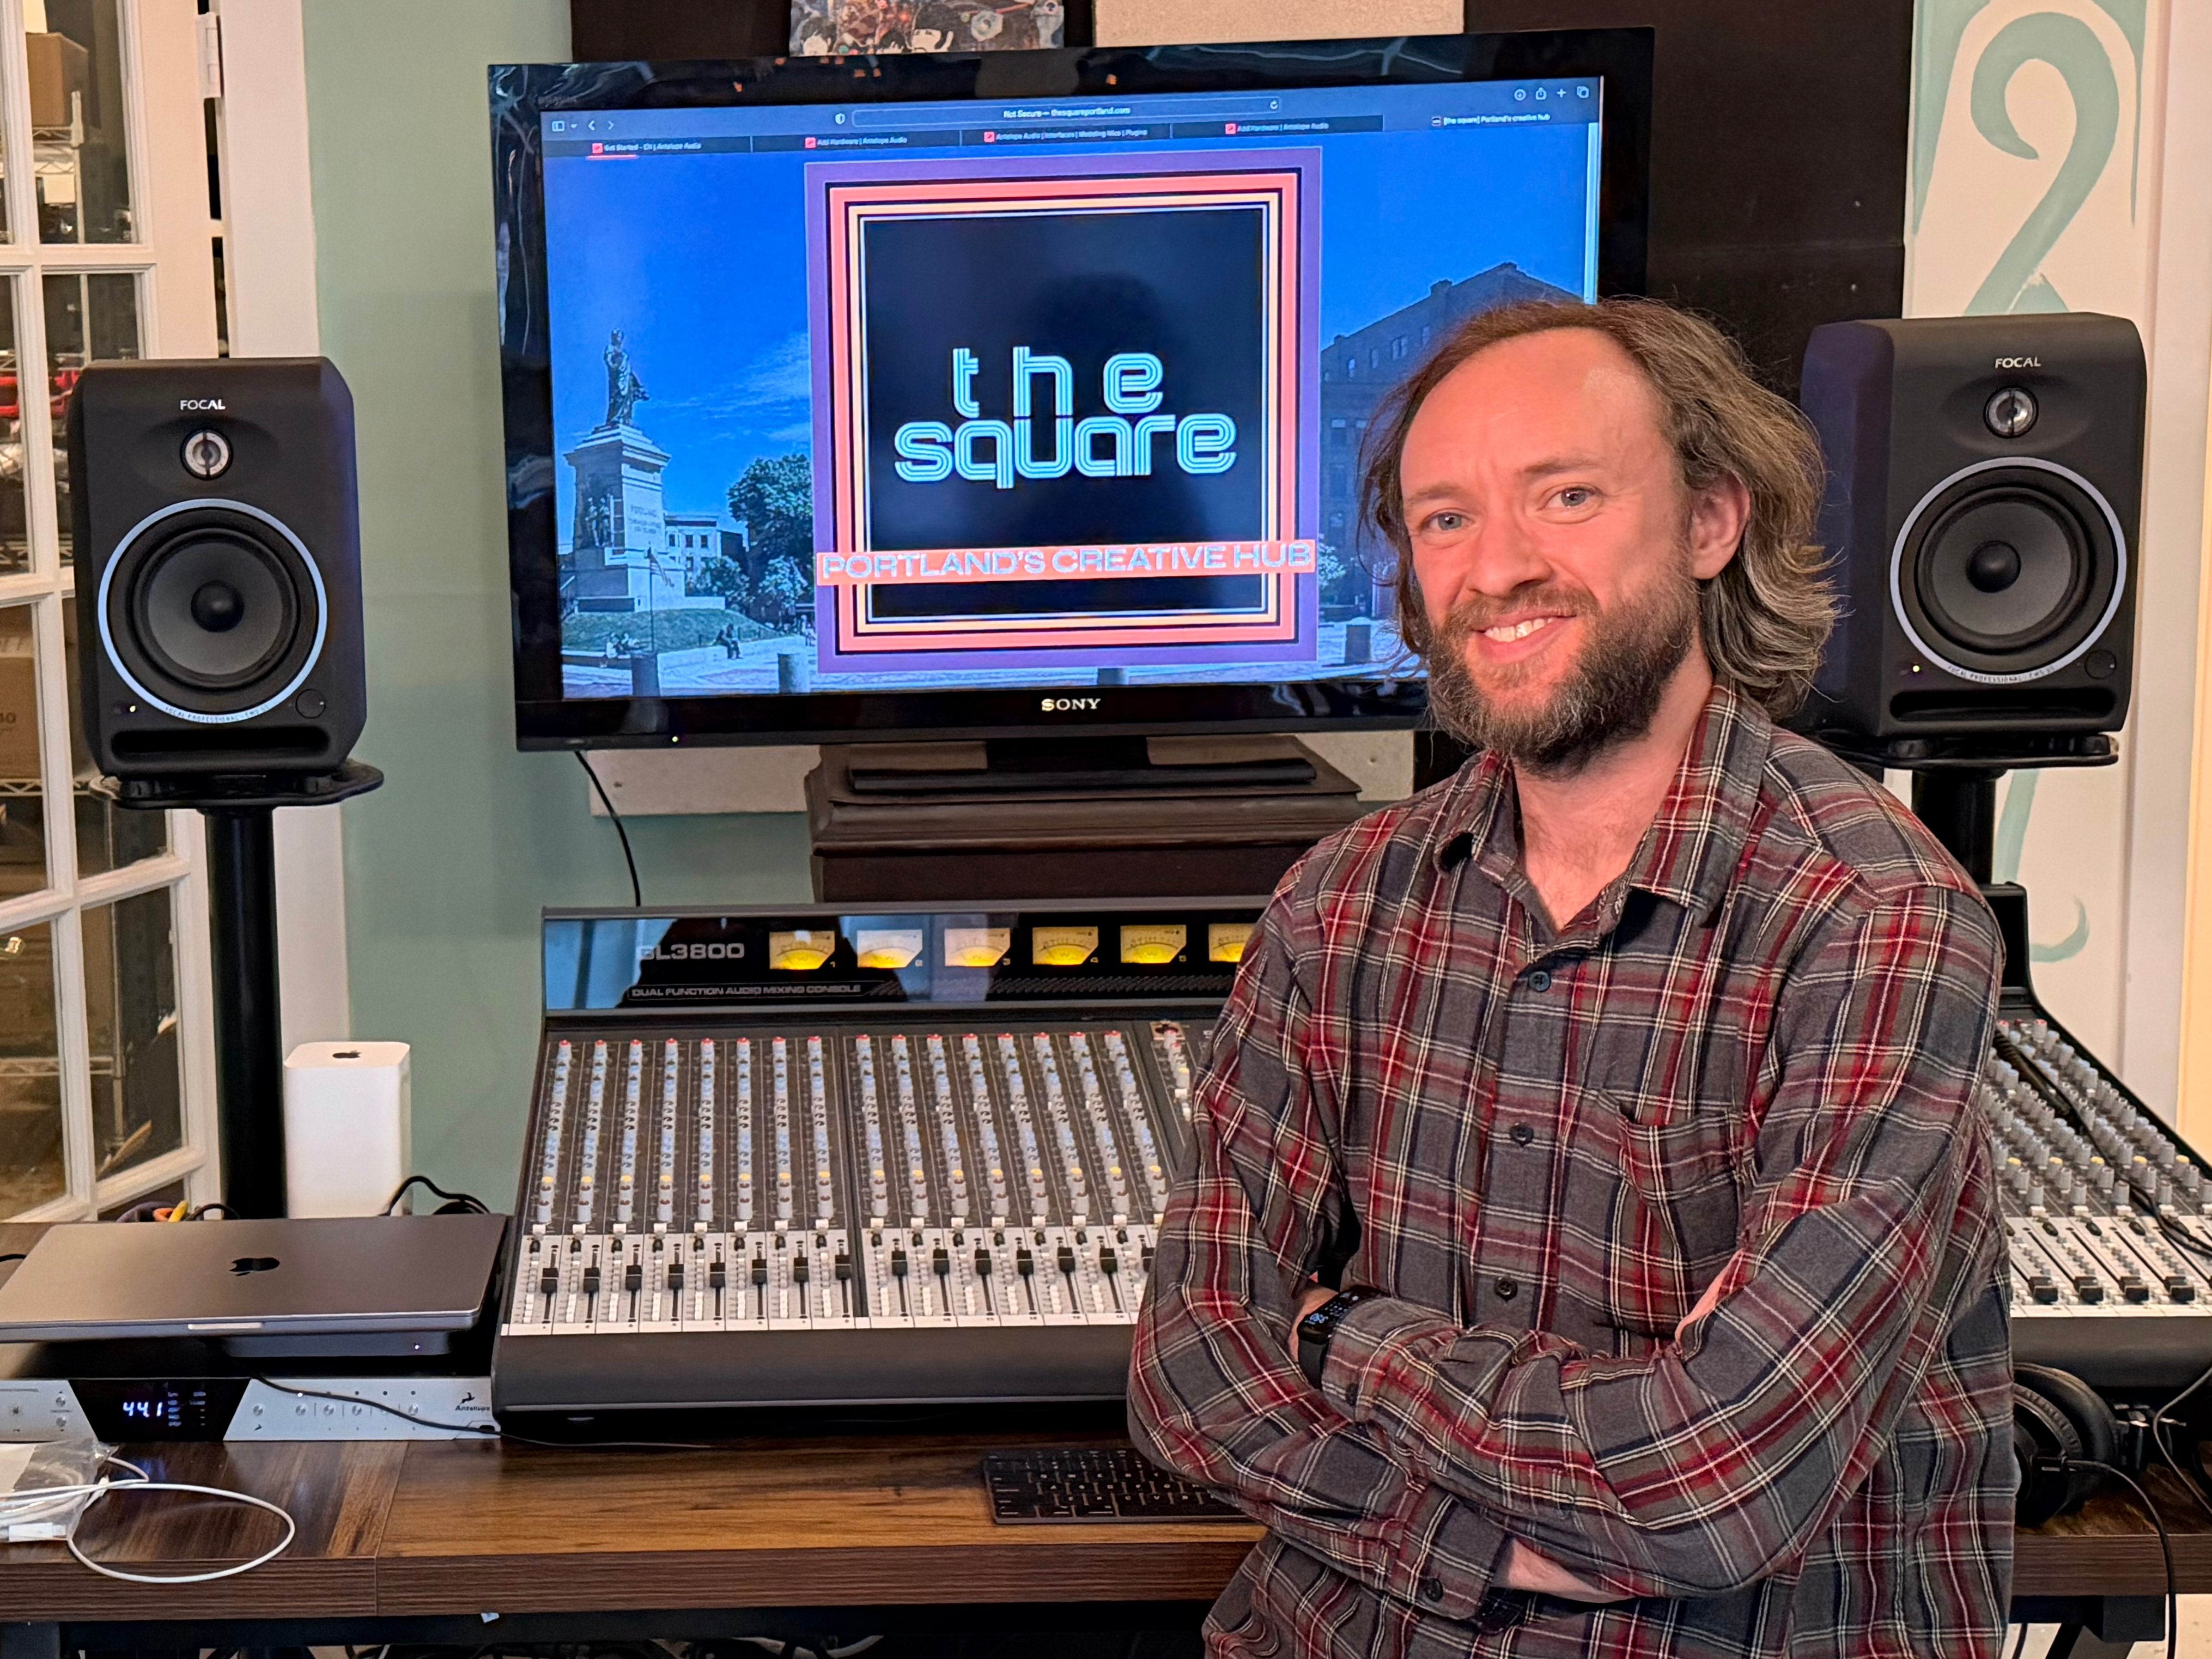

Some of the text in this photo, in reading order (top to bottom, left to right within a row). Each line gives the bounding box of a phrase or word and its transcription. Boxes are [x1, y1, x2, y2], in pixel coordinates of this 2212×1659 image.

[1017, 109, 1042, 118] Secure
[1051, 107, 1131, 117] thesquareportland.com
[1995, 356, 2042, 369] FOCAL
[953, 346, 1163, 419] the
[180, 399, 226, 410] FOCAL
[894, 413, 1237, 489] square
[823, 543, 1312, 578] PORTLAND'S CREATIVE HUB
[1041, 698, 1101, 711] SONY
[665, 987, 724, 996] FUNCTION
[725, 986, 762, 995] AUDIO
[763, 985, 805, 994] MIXING
[806, 984, 861, 993] CONSOLE
